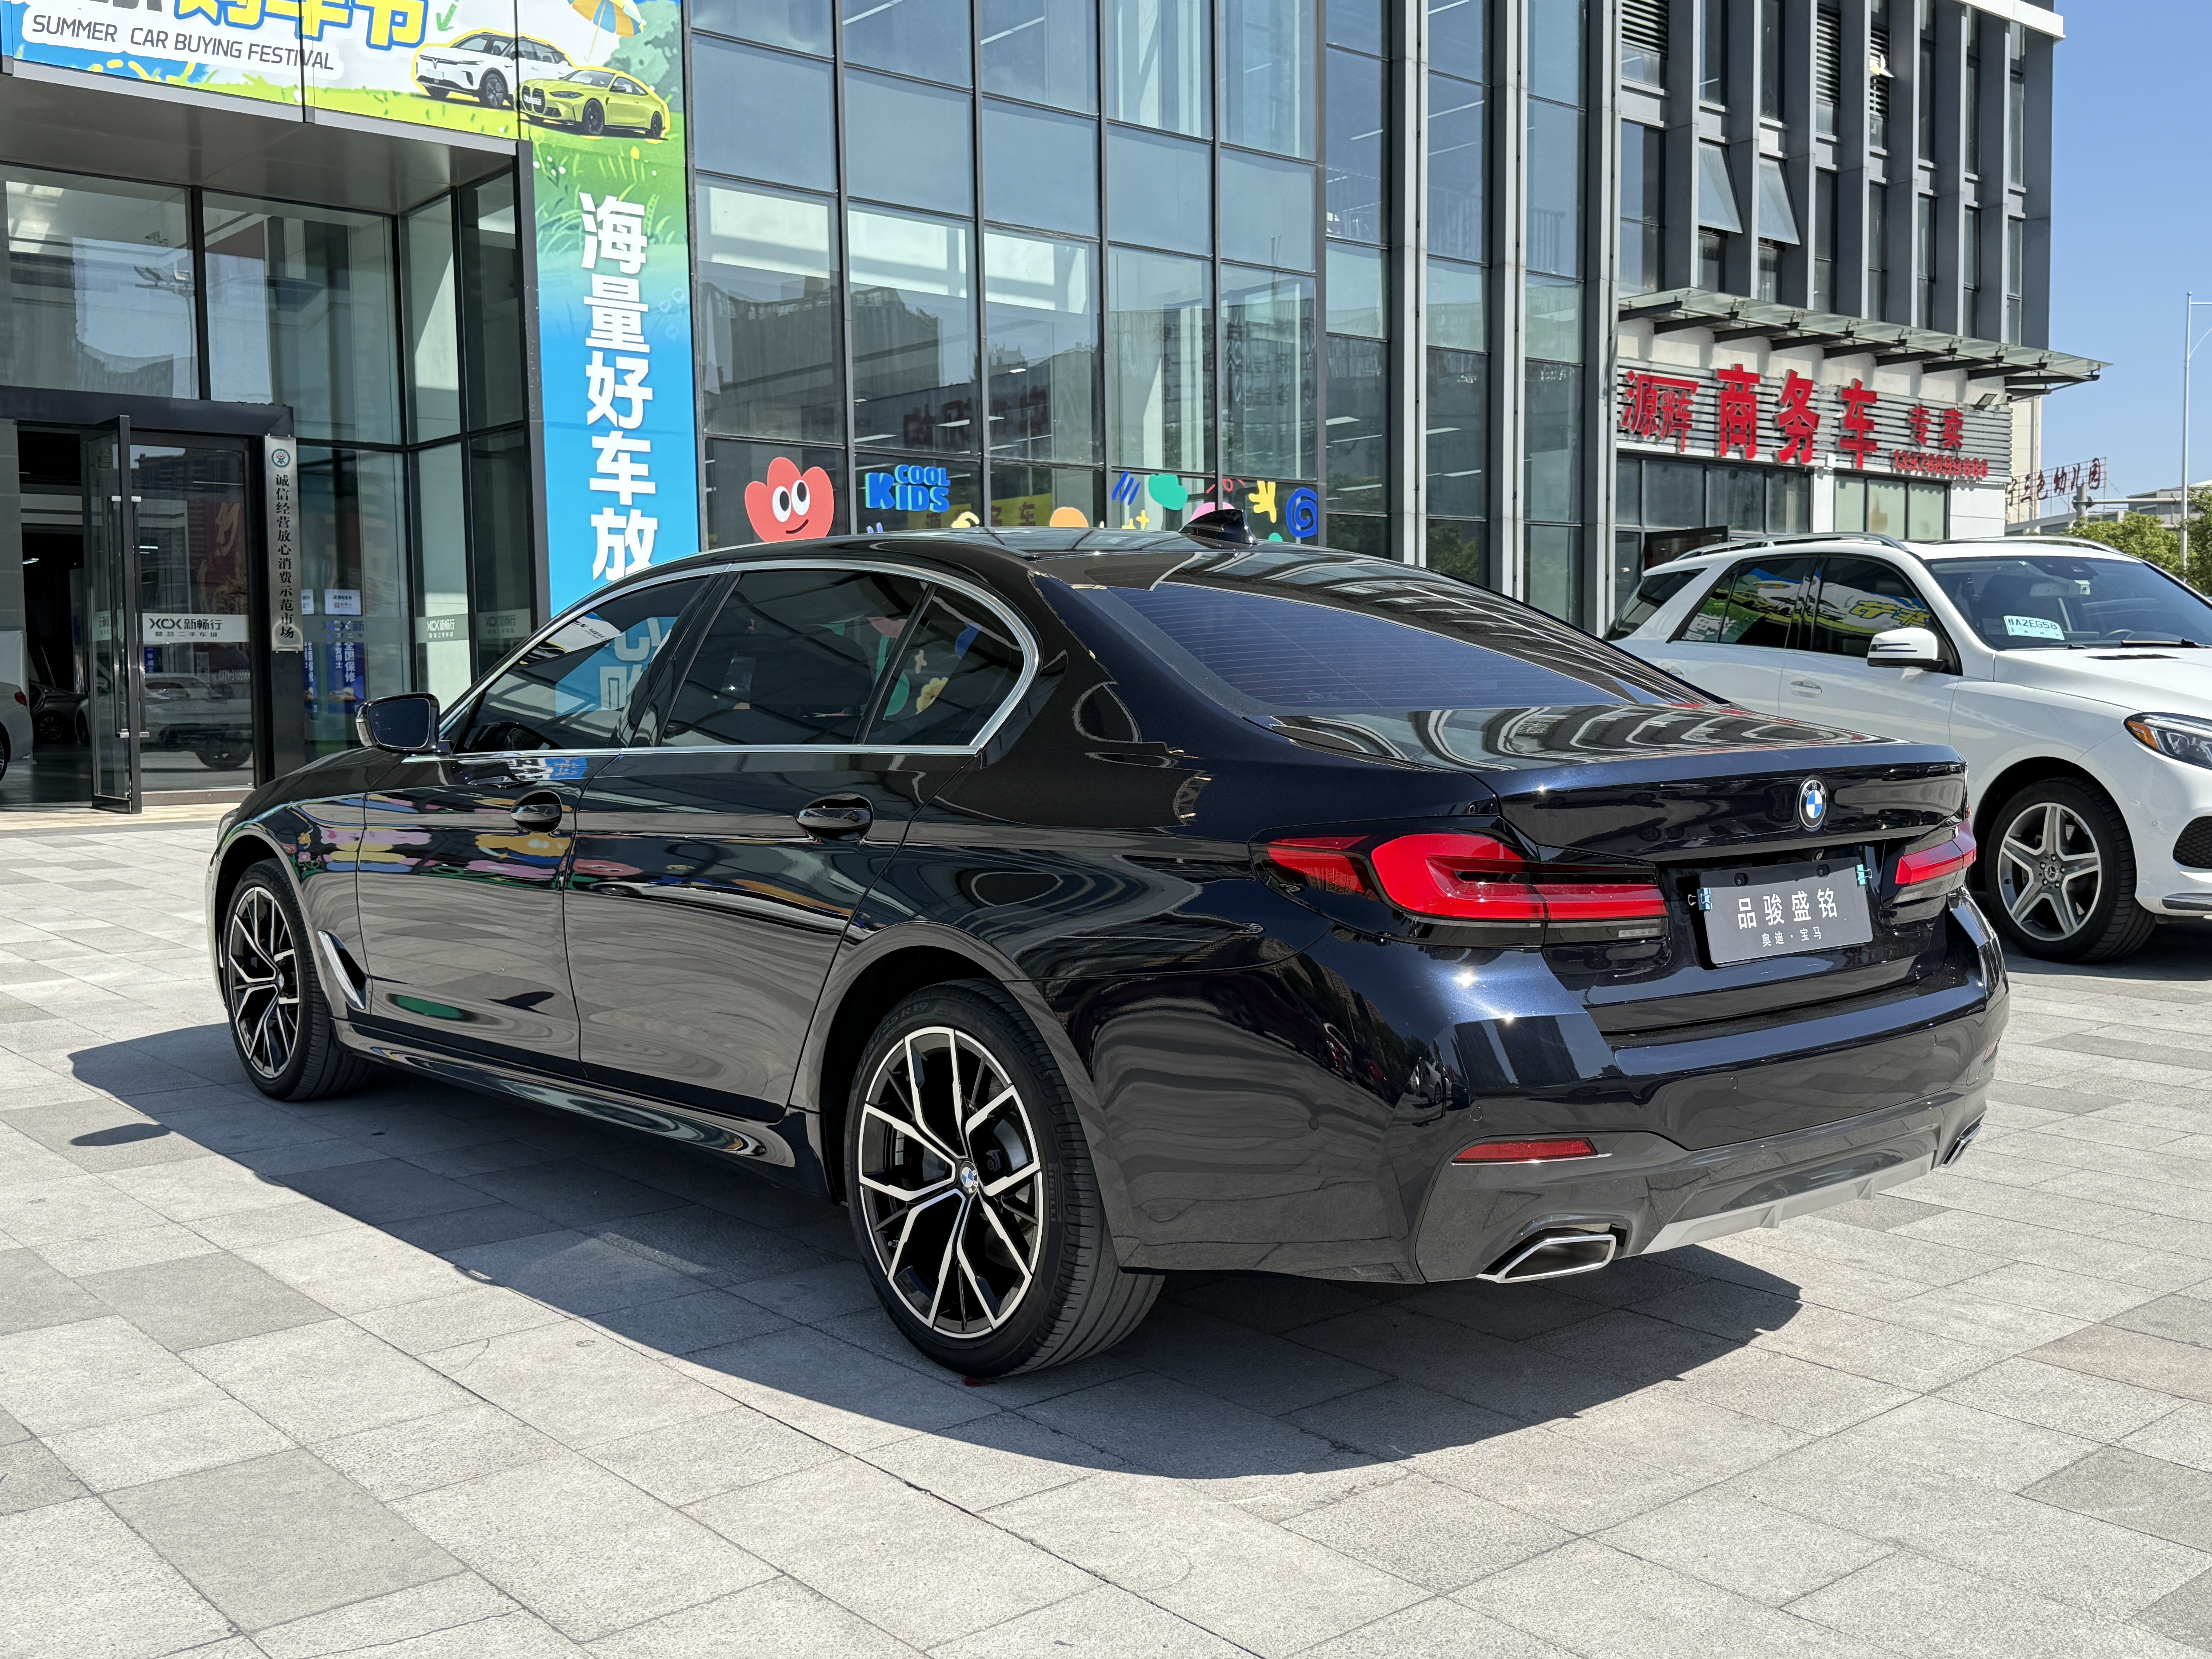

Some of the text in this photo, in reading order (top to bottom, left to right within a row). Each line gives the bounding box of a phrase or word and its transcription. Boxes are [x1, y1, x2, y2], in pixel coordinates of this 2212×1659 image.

[32, 14, 334, 70] SUMMER CAR BUYING FESTIVAL
[865, 472, 950, 513] KIDS
[894, 464, 950, 486] COOL
[275, 474, 294, 639] 诚信经营放心消费示范市场
[184, 618, 222, 630] 新畅行
[1738, 887, 1838, 929] 品骏盛铭
